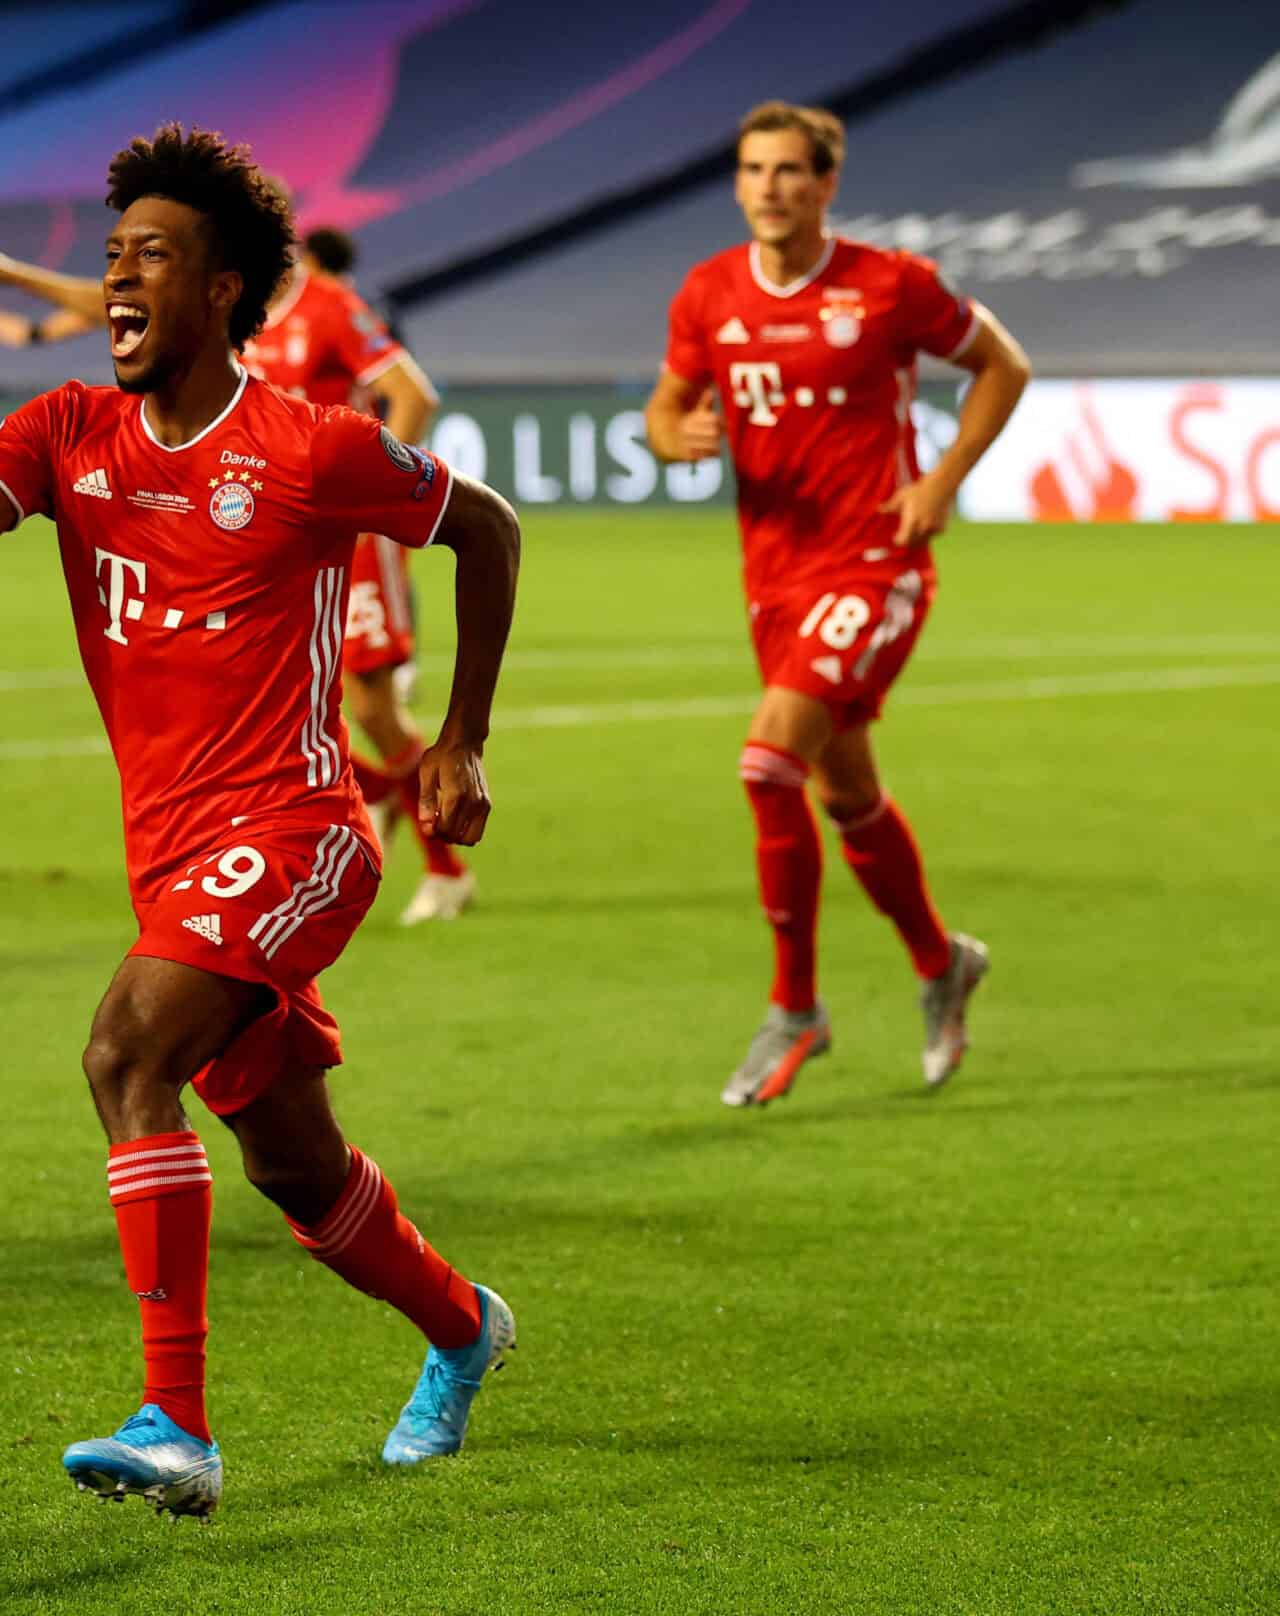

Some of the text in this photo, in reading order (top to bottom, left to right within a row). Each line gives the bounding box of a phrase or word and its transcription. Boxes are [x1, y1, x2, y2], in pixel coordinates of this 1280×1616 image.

[220, 450, 267, 470] Danke
[73, 483, 112, 500] adidas
[95, 546, 147, 646] T
[798, 592, 870, 650] 18
[171, 846, 266, 898] 9
[181, 919, 223, 945] adidas
